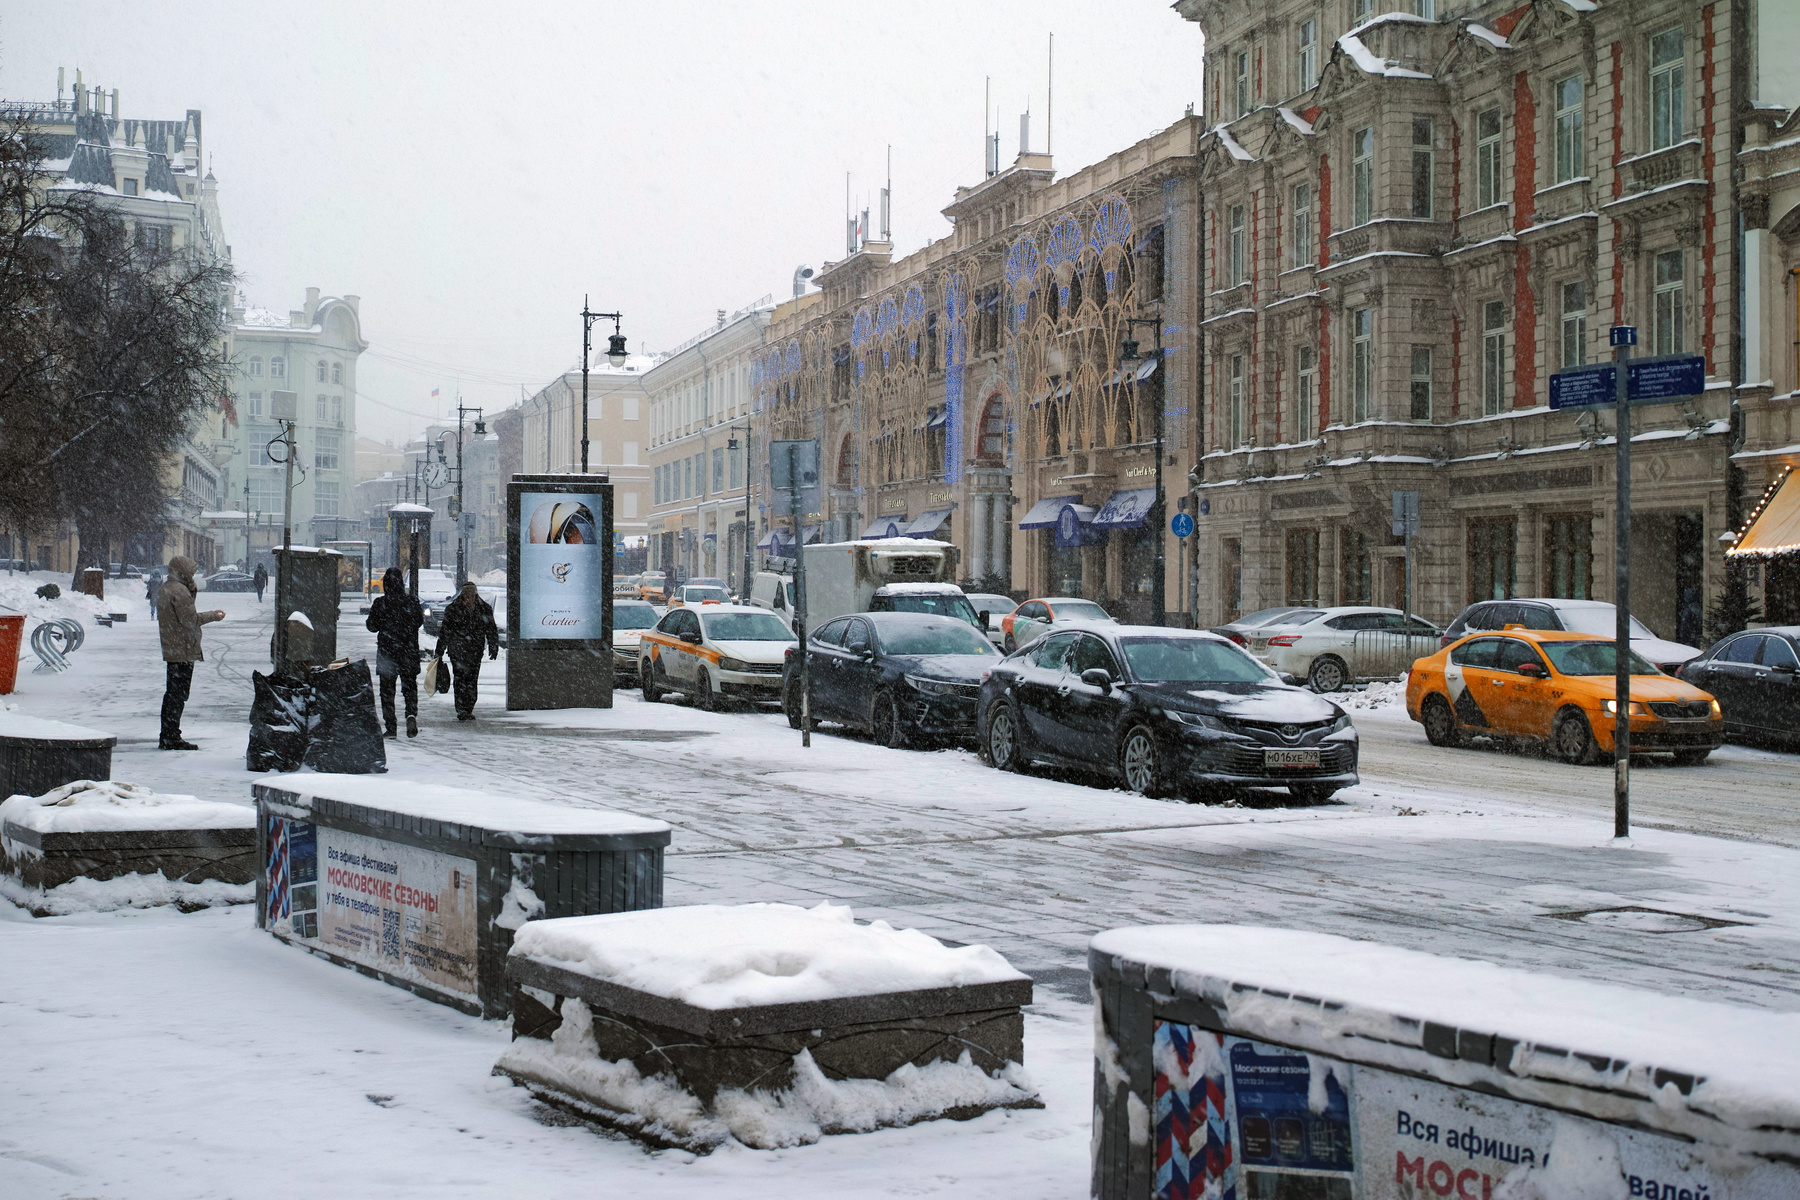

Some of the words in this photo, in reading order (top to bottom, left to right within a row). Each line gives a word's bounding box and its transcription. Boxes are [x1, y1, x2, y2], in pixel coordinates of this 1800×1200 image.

[541, 613, 580, 626] Cartier
[327, 845, 339, 861] Вся
[339, 849, 361, 866] афиша
[360, 853, 399, 876] фестивалей
[326, 891, 331, 905] у
[331, 892, 346, 906] тебя
[350, 898, 380, 916] телефоне
[327, 866, 393, 901] МОСКОВСКИЕ
[394, 883, 439, 914] СЕЗОНЫ
[1397, 1109, 1439, 1144] Вся
[1446, 1125, 1536, 1168] афиша
